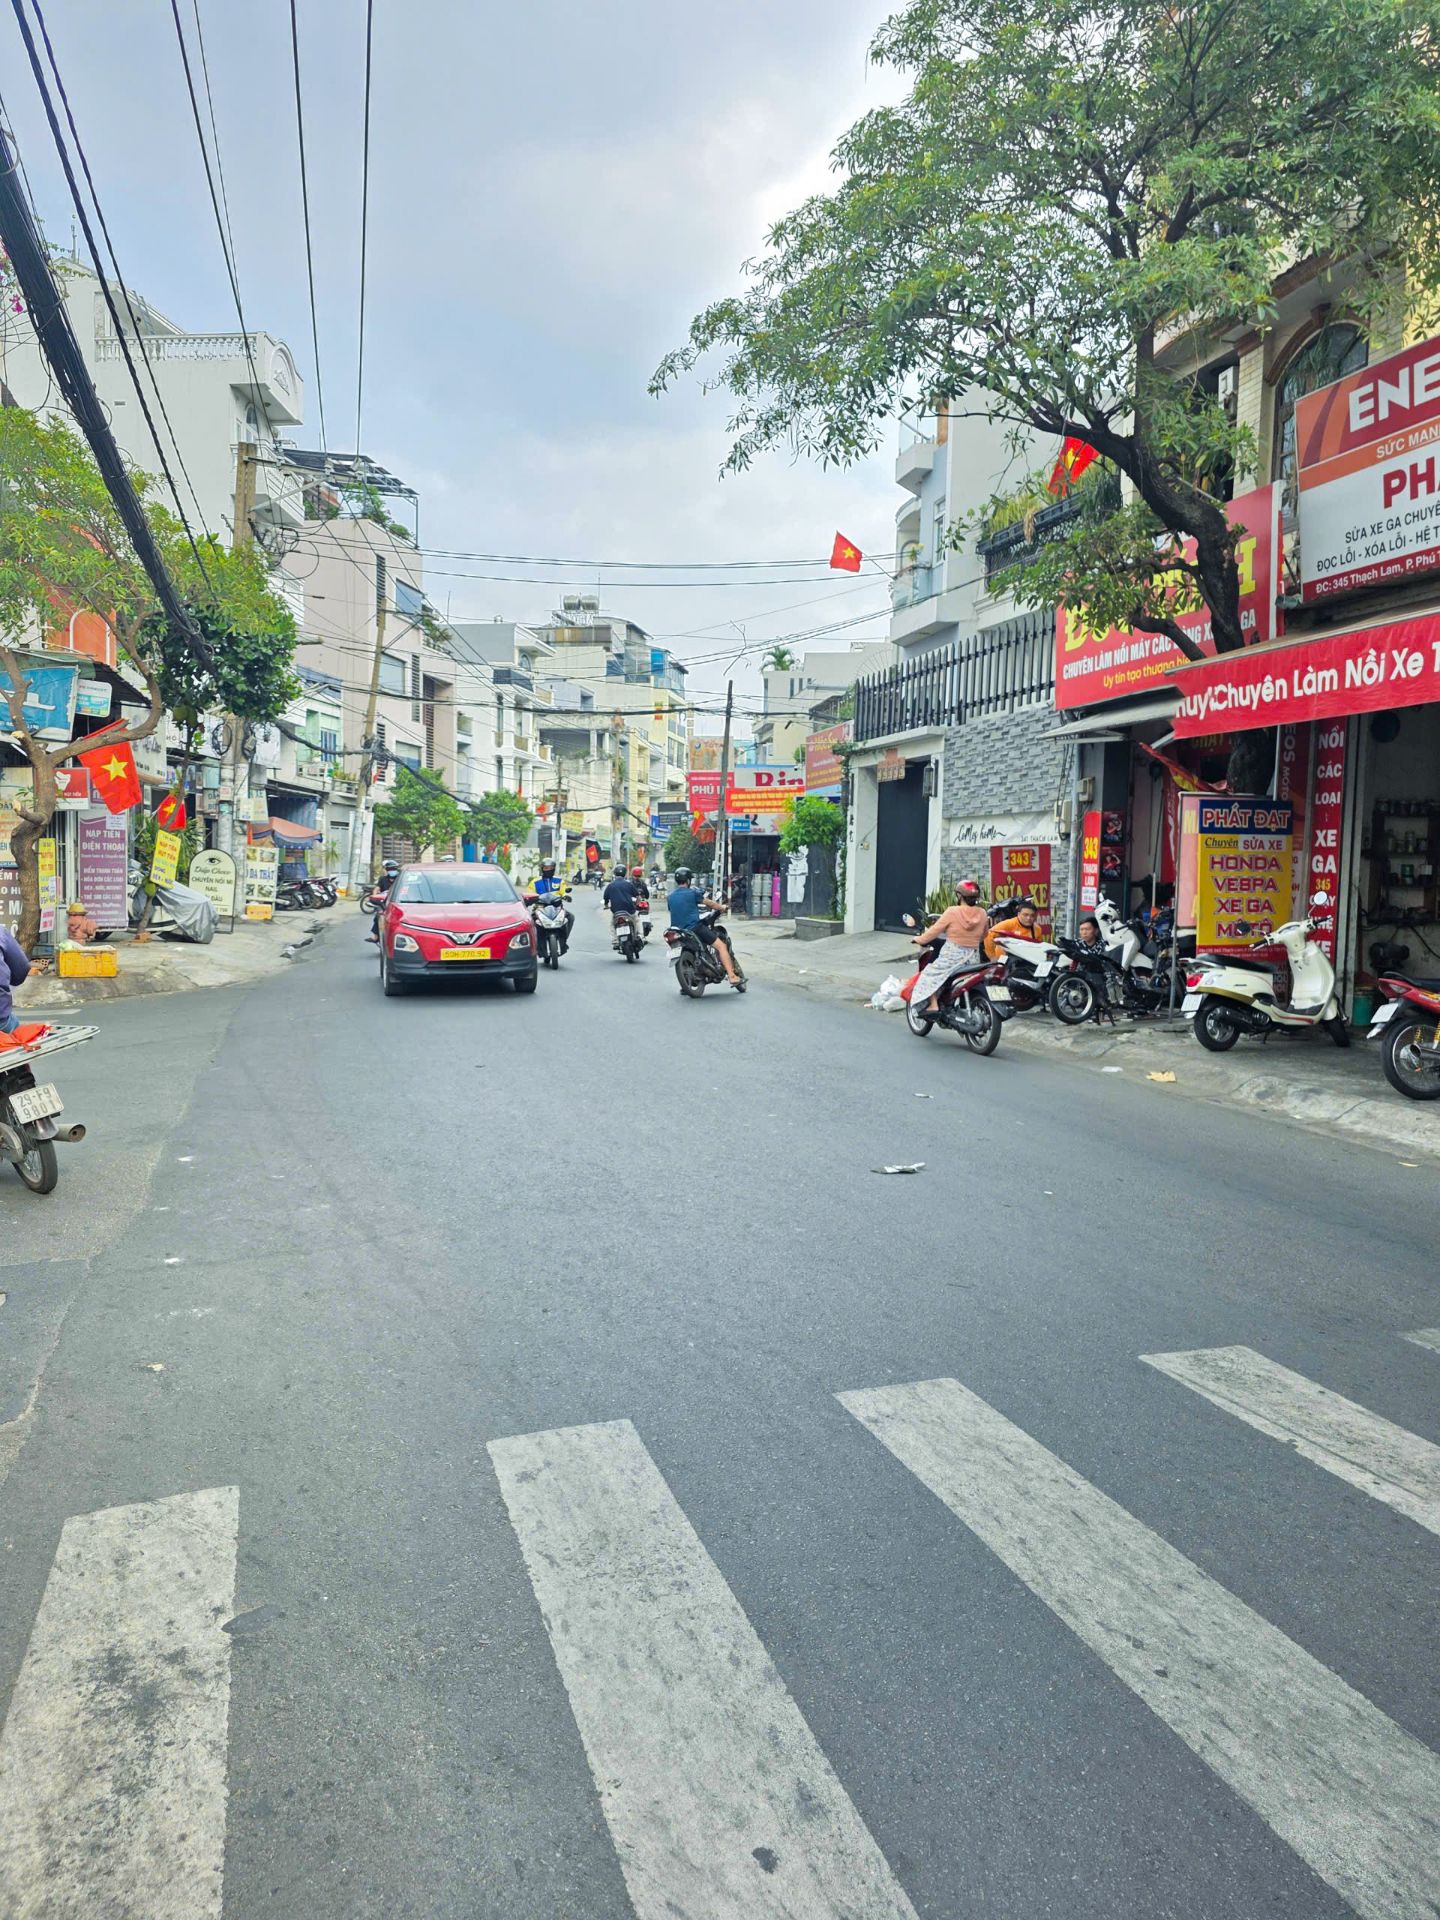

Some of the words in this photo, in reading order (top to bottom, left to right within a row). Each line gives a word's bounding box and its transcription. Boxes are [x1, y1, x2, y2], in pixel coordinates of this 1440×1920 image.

[1376, 437, 1405, 458] SỨC
[1383, 455, 1440, 509] PH
[1345, 526, 1367, 543] SỬA
[1370, 521, 1383, 537] XE
[1386, 516, 1401, 532] GA
[1317, 556, 1337, 572] ĐỌC
[1340, 546, 1356, 565] LỖI
[1364, 540, 1387, 559] XÓA
[1389, 532, 1406, 551] LỖI
[1416, 525, 1430, 545] HỆ
[1316, 582, 1332, 593] ĐC:
[1333, 577, 1349, 589] 345
[1350, 568, 1378, 585] Thạch
[1380, 563, 1404, 577] Lam,
[1405, 559, 1415, 570] P.
[1416, 553, 1436, 566] Phú
[1063, 656, 1093, 680] CHUYÊN
[1095, 652, 1113, 674] LÀM
[1131, 635, 1150, 661] MÁY
[1241, 608, 1256, 631] GA
[1103, 675, 1114, 688] Uy
[1127, 667, 1141, 684] tạo
[1293, 666, 1338, 697] Làm
[1345, 648, 1385, 688] Nồi
[1390, 647, 1424, 681] Xe
[1318, 726, 1344, 749] NỒI
[1317, 761, 1342, 778] CÁC
[692, 783, 714, 794] PHÚ
[1315, 792, 1340, 807] LOẠI
[1202, 803, 1251, 828] PHÁT
[1254, 808, 1291, 831] ĐẠT
[82, 842, 100, 852] ĐIỆN
[102, 842, 124, 852] THOẠI
[1205, 836, 1239, 848] Chuyên
[1243, 837, 1265, 850] SỬA
[1268, 840, 1282, 850] XE
[1315, 829, 1337, 847] XE
[1084, 837, 1098, 860] 343
[1010, 852, 1030, 865] 343
[1210, 854, 1282, 872] HONDA
[1312, 855, 1336, 873] GA
[1214, 877, 1279, 892] VESPA
[1315, 878, 1330, 890] 345
[1028, 884, 1048, 908] XE
[1216, 898, 1243, 914] XE
[1247, 898, 1275, 914] GA
